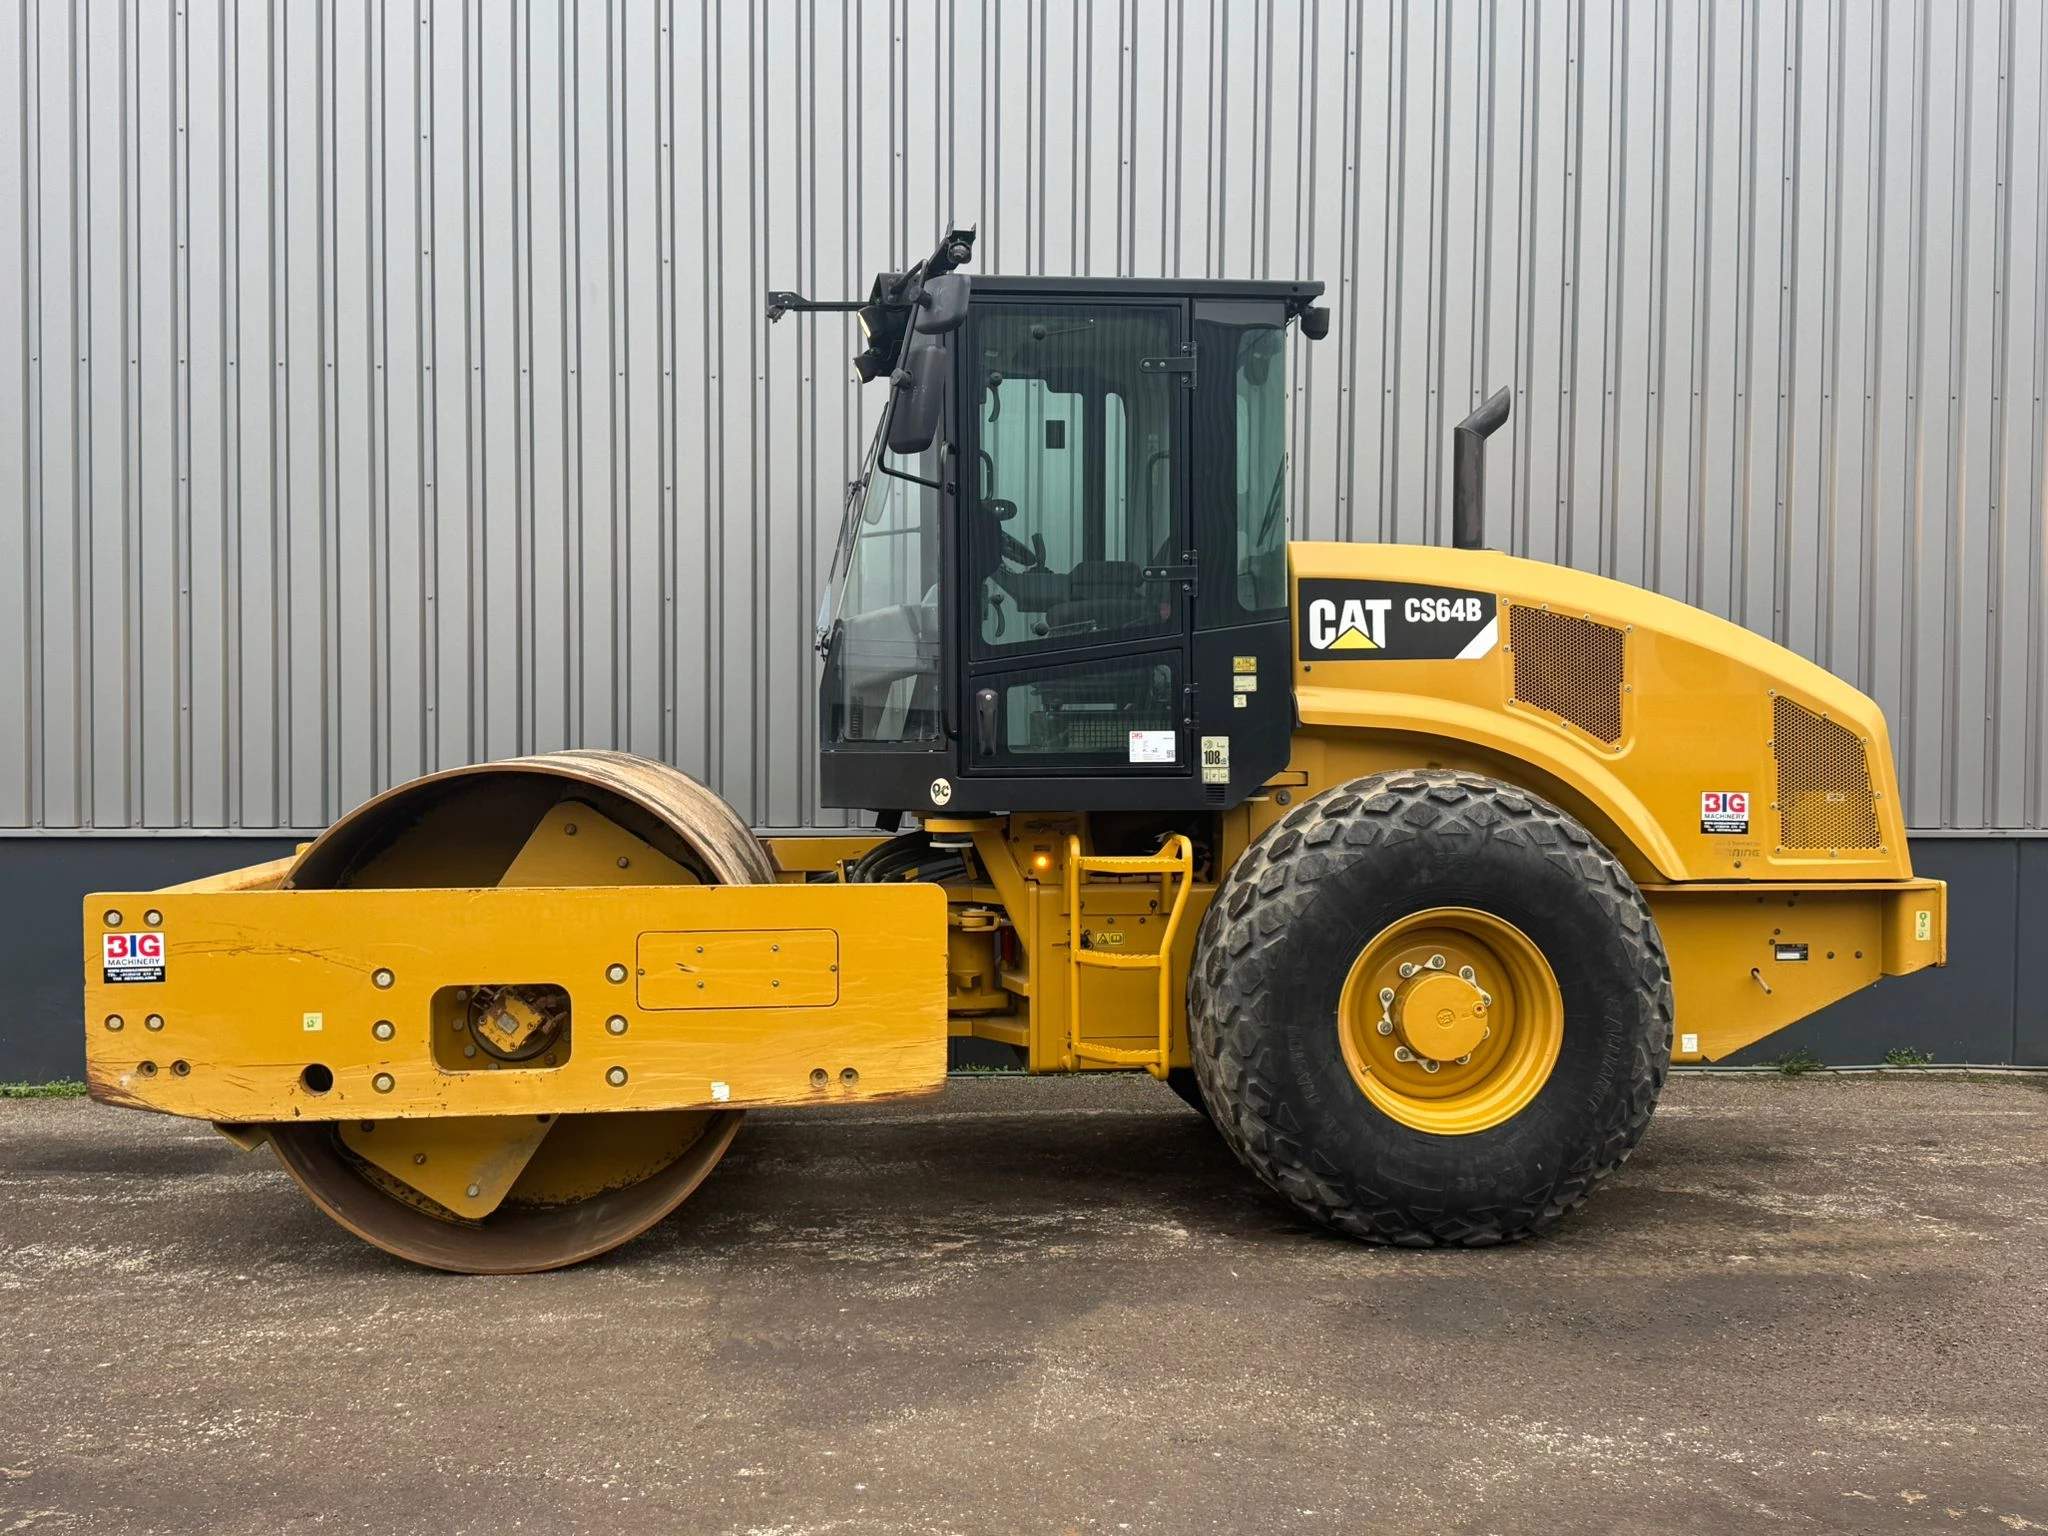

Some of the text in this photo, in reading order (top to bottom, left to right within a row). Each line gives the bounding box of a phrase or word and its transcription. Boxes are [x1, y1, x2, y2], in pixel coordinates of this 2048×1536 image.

[1404, 597, 1482, 623] CS64B
[1309, 599, 1392, 650] CAT
[1204, 750, 1220, 764] 108
[1705, 793, 1745, 812] BIG
[107, 934, 160, 958] BIG
[108, 958, 160, 966] MACHINERY
